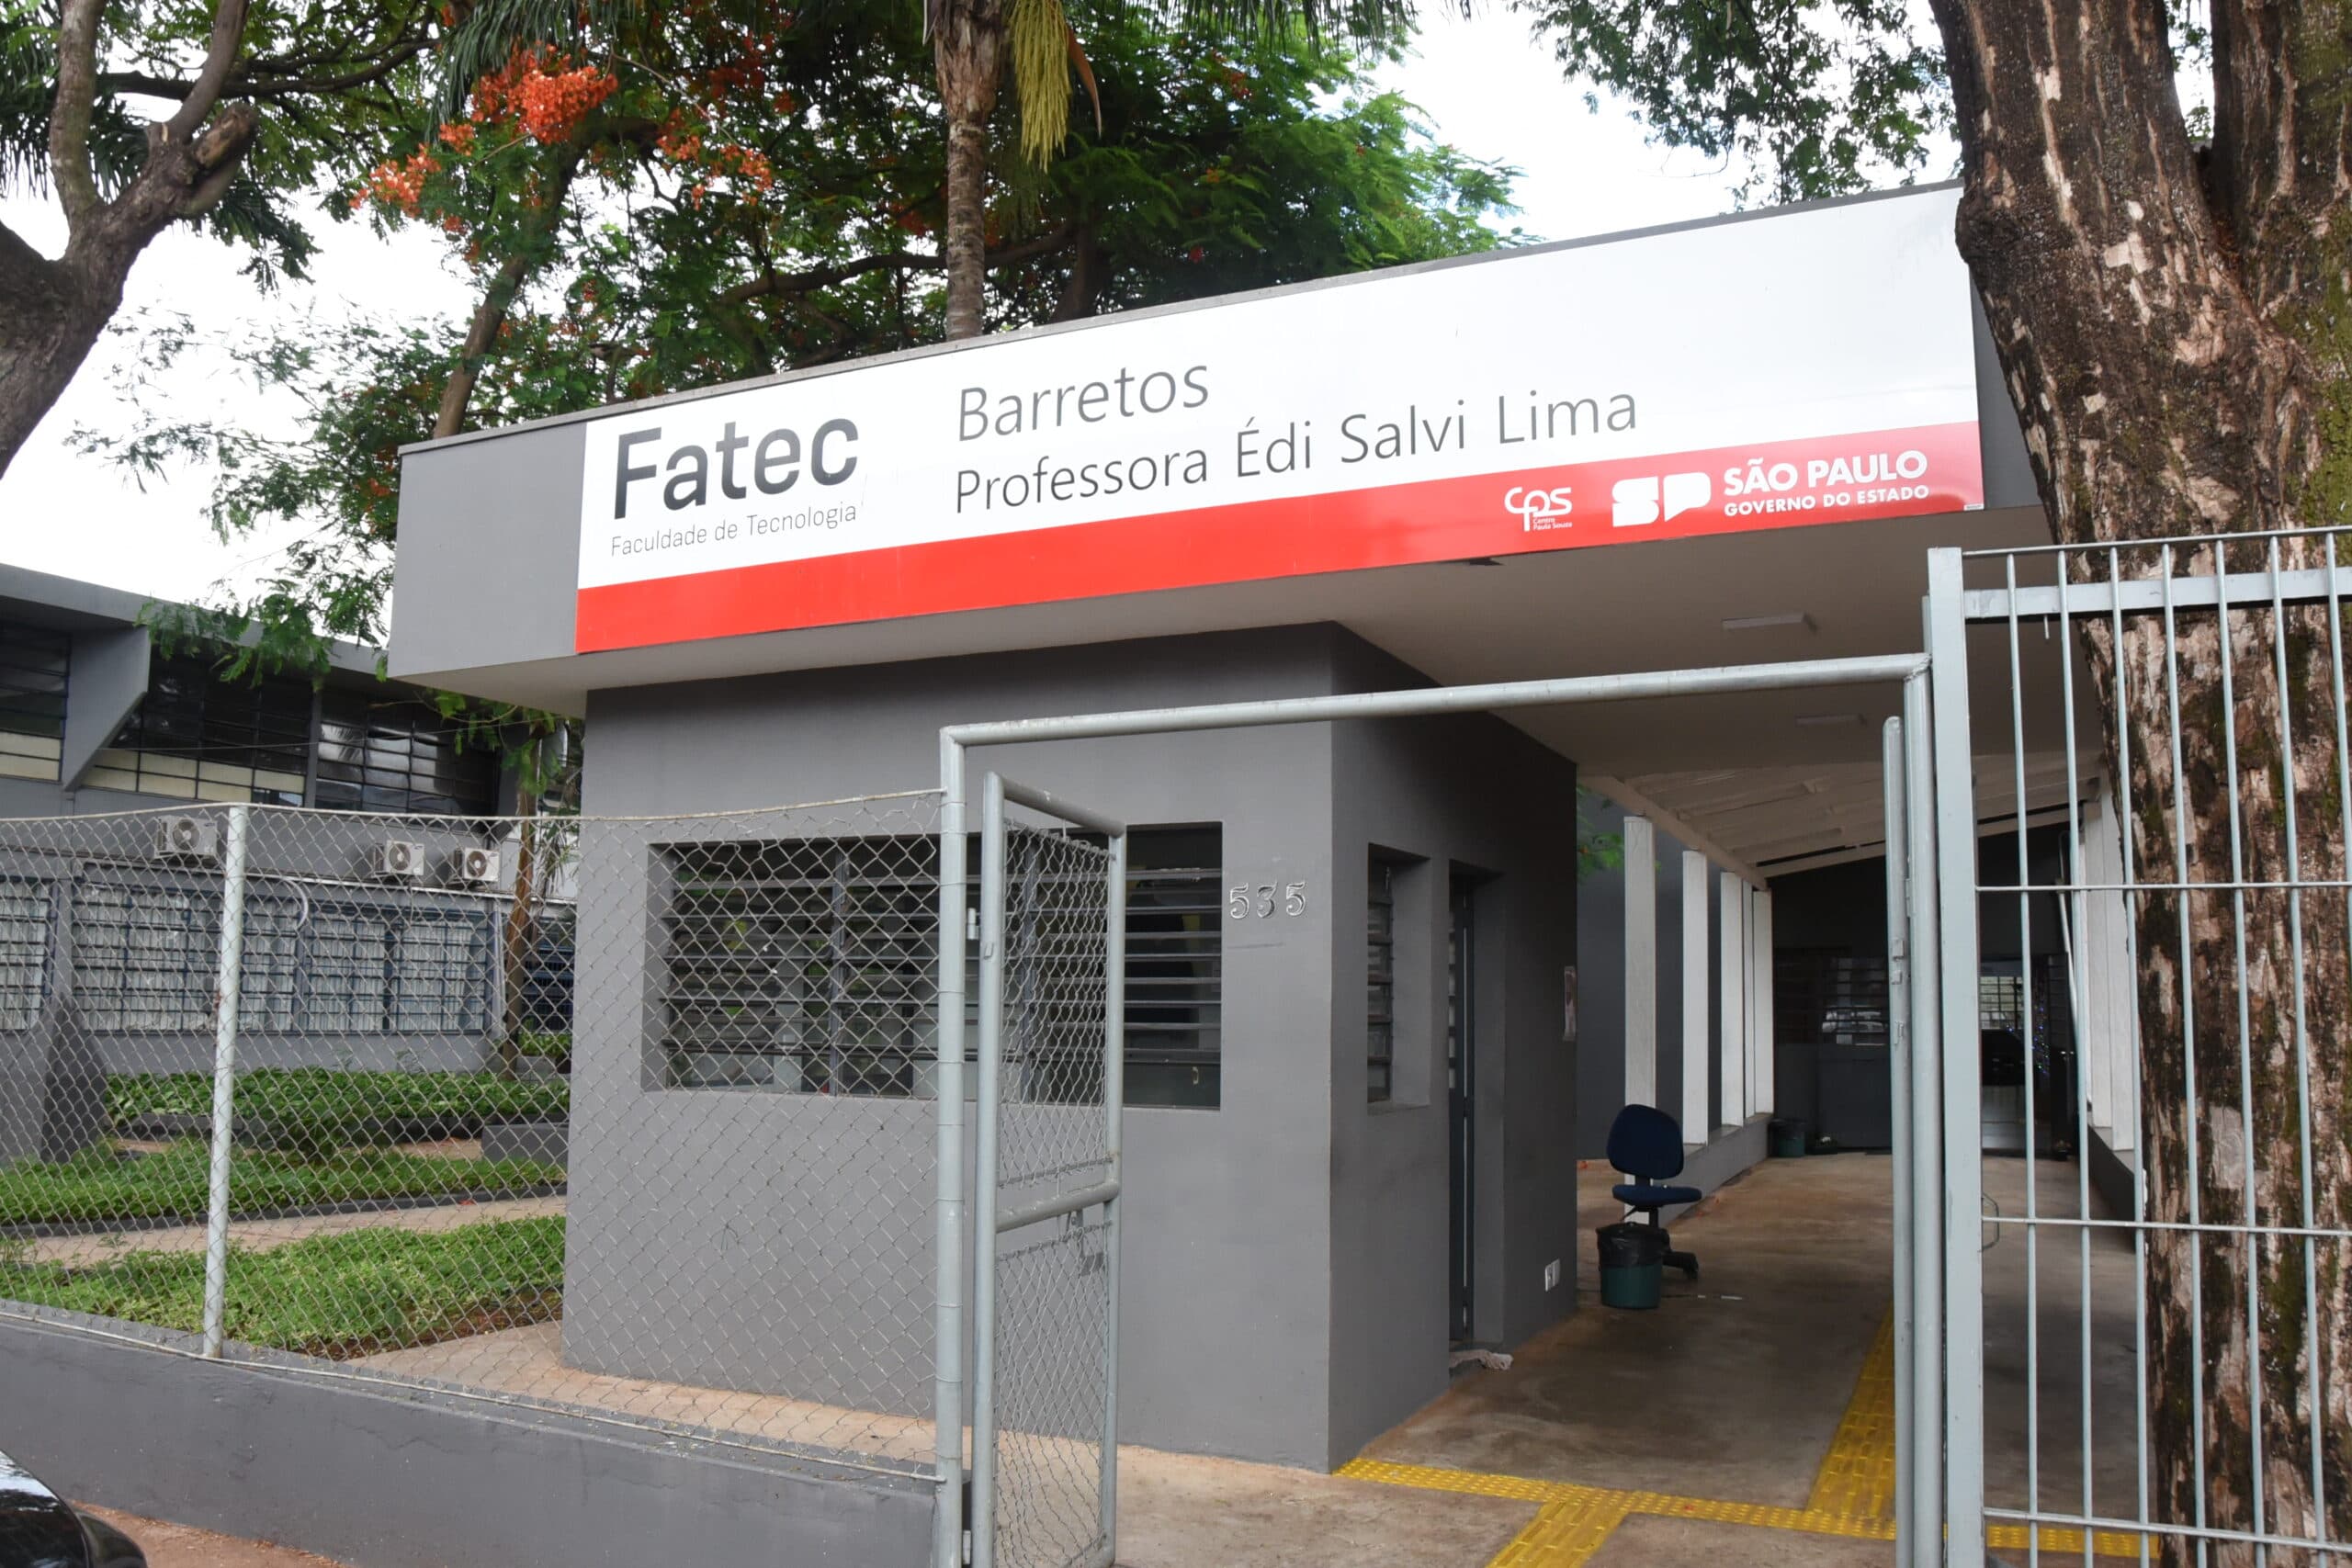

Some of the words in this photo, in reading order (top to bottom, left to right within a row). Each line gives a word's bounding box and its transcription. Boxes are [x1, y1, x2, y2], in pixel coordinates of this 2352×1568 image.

[959, 365, 1209, 441] Barretos
[614, 418, 859, 520] Fatec
[957, 449, 1208, 513] Professora
[1237, 416, 1311, 479] Édi
[1340, 399, 1464, 464] Salvi
[1498, 389, 1637, 445] Lima
[1724, 457, 1798, 496] SÃO
[1807, 450, 1928, 488] PAULO
[1611, 471, 1712, 528] SP
[1724, 495, 1816, 516] GOVERNO
[1823, 491, 1850, 508] DO
[1857, 485, 1929, 504] ESTADO
[611, 525, 707, 557] Faculdade
[714, 520, 738, 541] de
[746, 501, 856, 536] Tecnologia
[1229, 879, 1306, 919] 535
